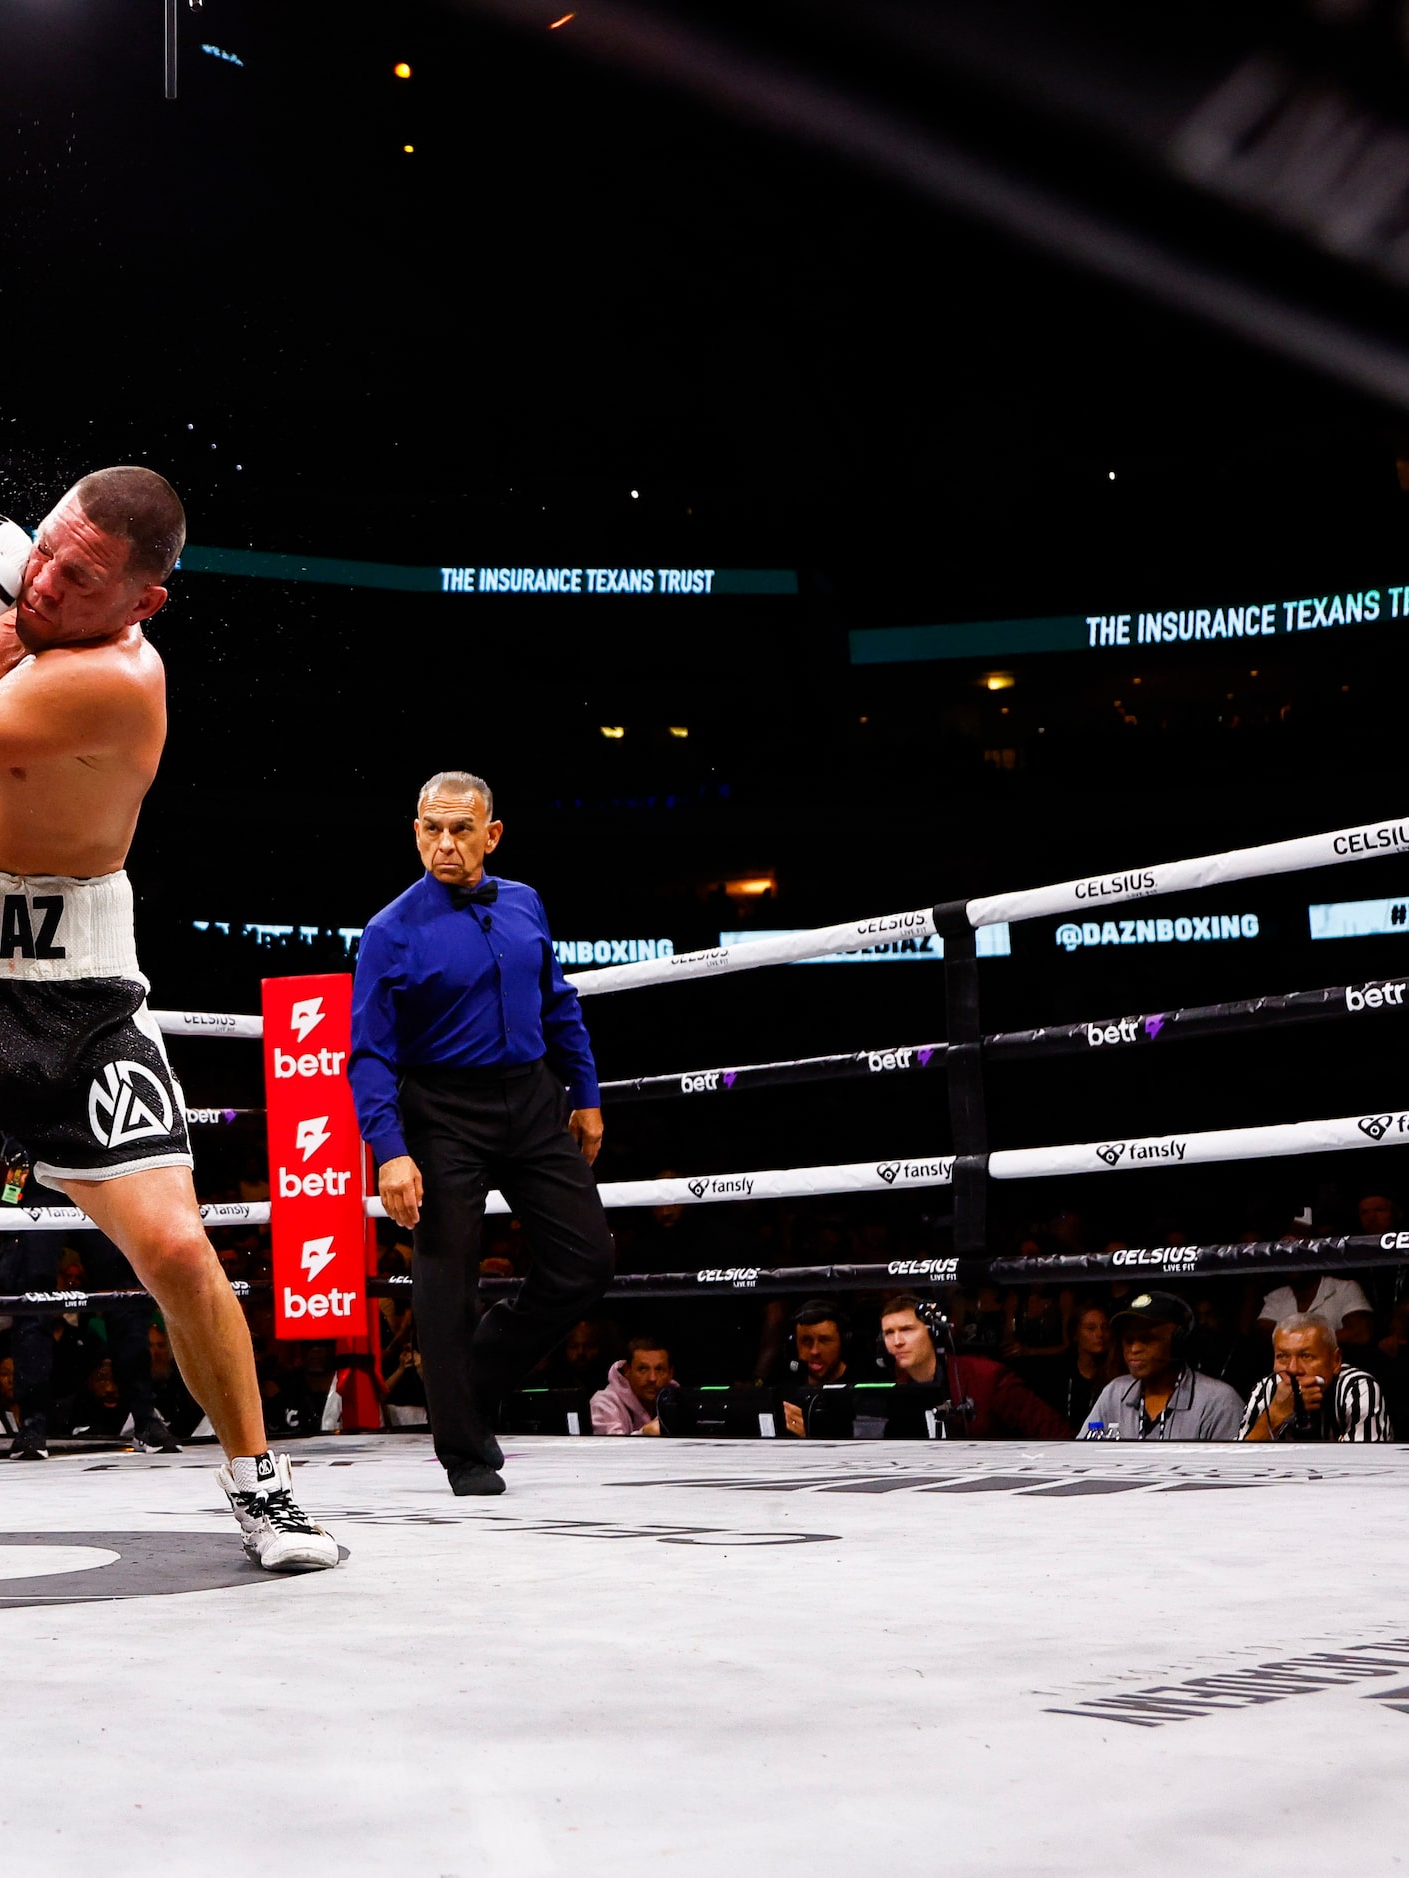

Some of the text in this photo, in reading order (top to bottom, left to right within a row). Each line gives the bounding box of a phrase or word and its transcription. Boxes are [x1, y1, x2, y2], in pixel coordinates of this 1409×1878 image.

[441, 568, 715, 593] THE INSURANCE TEXANS TRUST
[1085, 614, 1131, 647] THE
[1137, 604, 1276, 644] INSURANCE
[1282, 589, 1381, 632] TEXANS
[1055, 914, 1260, 951] @DAZNBOXING
[1345, 981, 1407, 1012] betr
[1087, 1016, 1140, 1048] betr
[273, 1048, 345, 1079] betr
[868, 1048, 913, 1073] betr
[681, 1072, 720, 1094] betr
[1129, 1140, 1187, 1160] fansly
[279, 1165, 351, 1199] betr
[904, 1158, 952, 1181] fansly
[712, 1177, 754, 1194] fansly
[930, 1273, 945, 1281] LIVE
[1163, 1263, 1195, 1273] LIVE FIT
[747, 1279, 756, 1288] FIT
[79, 1300, 88, 1308] FIT
[283, 1286, 356, 1319] betr
